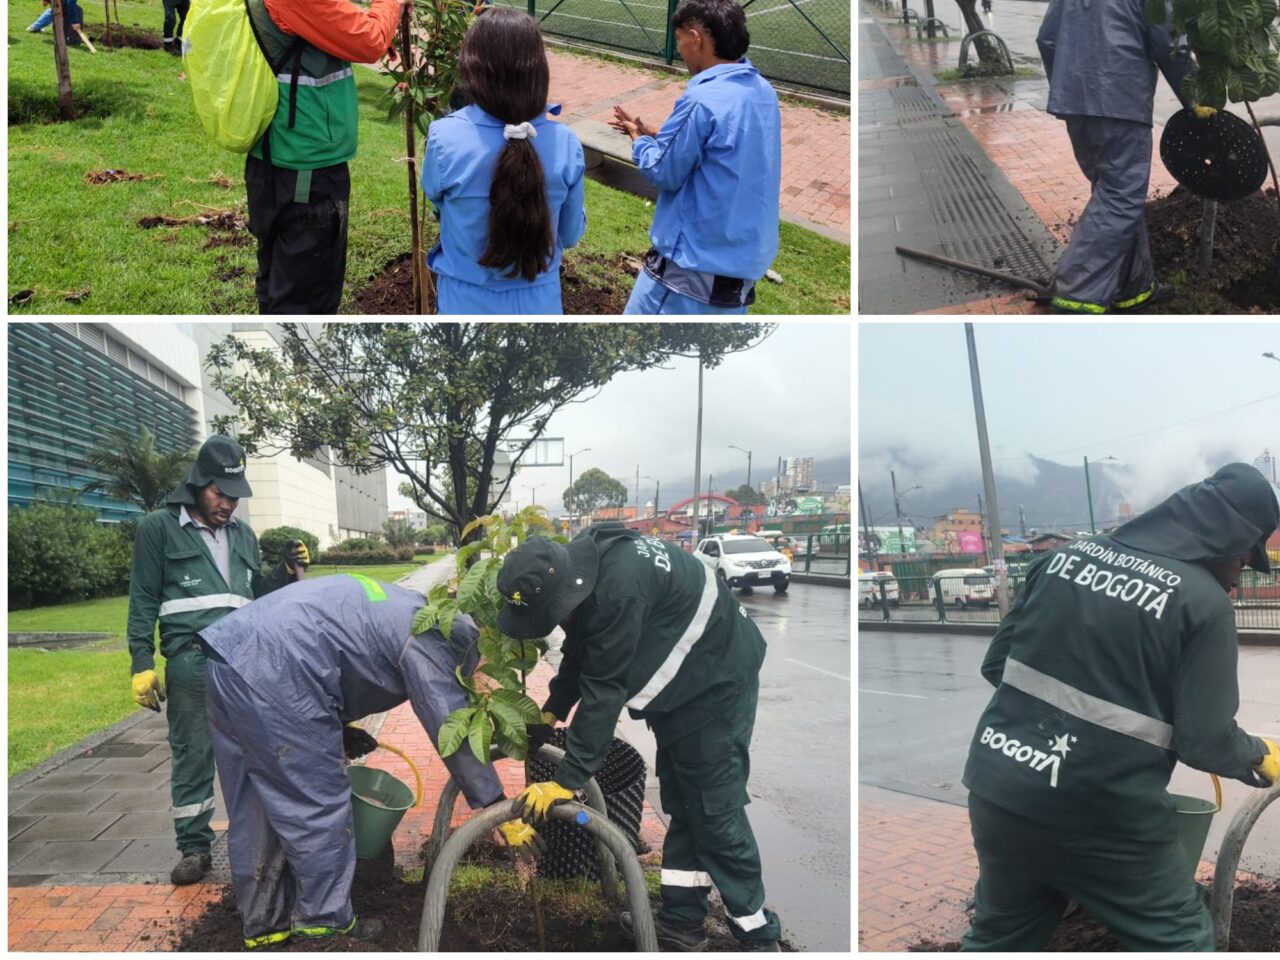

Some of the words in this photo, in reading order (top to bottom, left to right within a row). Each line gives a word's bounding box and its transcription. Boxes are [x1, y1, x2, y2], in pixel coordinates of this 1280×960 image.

[1046, 552, 1081, 580] DE
[1074, 563, 1175, 620] BOGOTÁ
[1069, 540, 1117, 565] JARDÍN
[1114, 554, 1182, 587] BOTÁNICO
